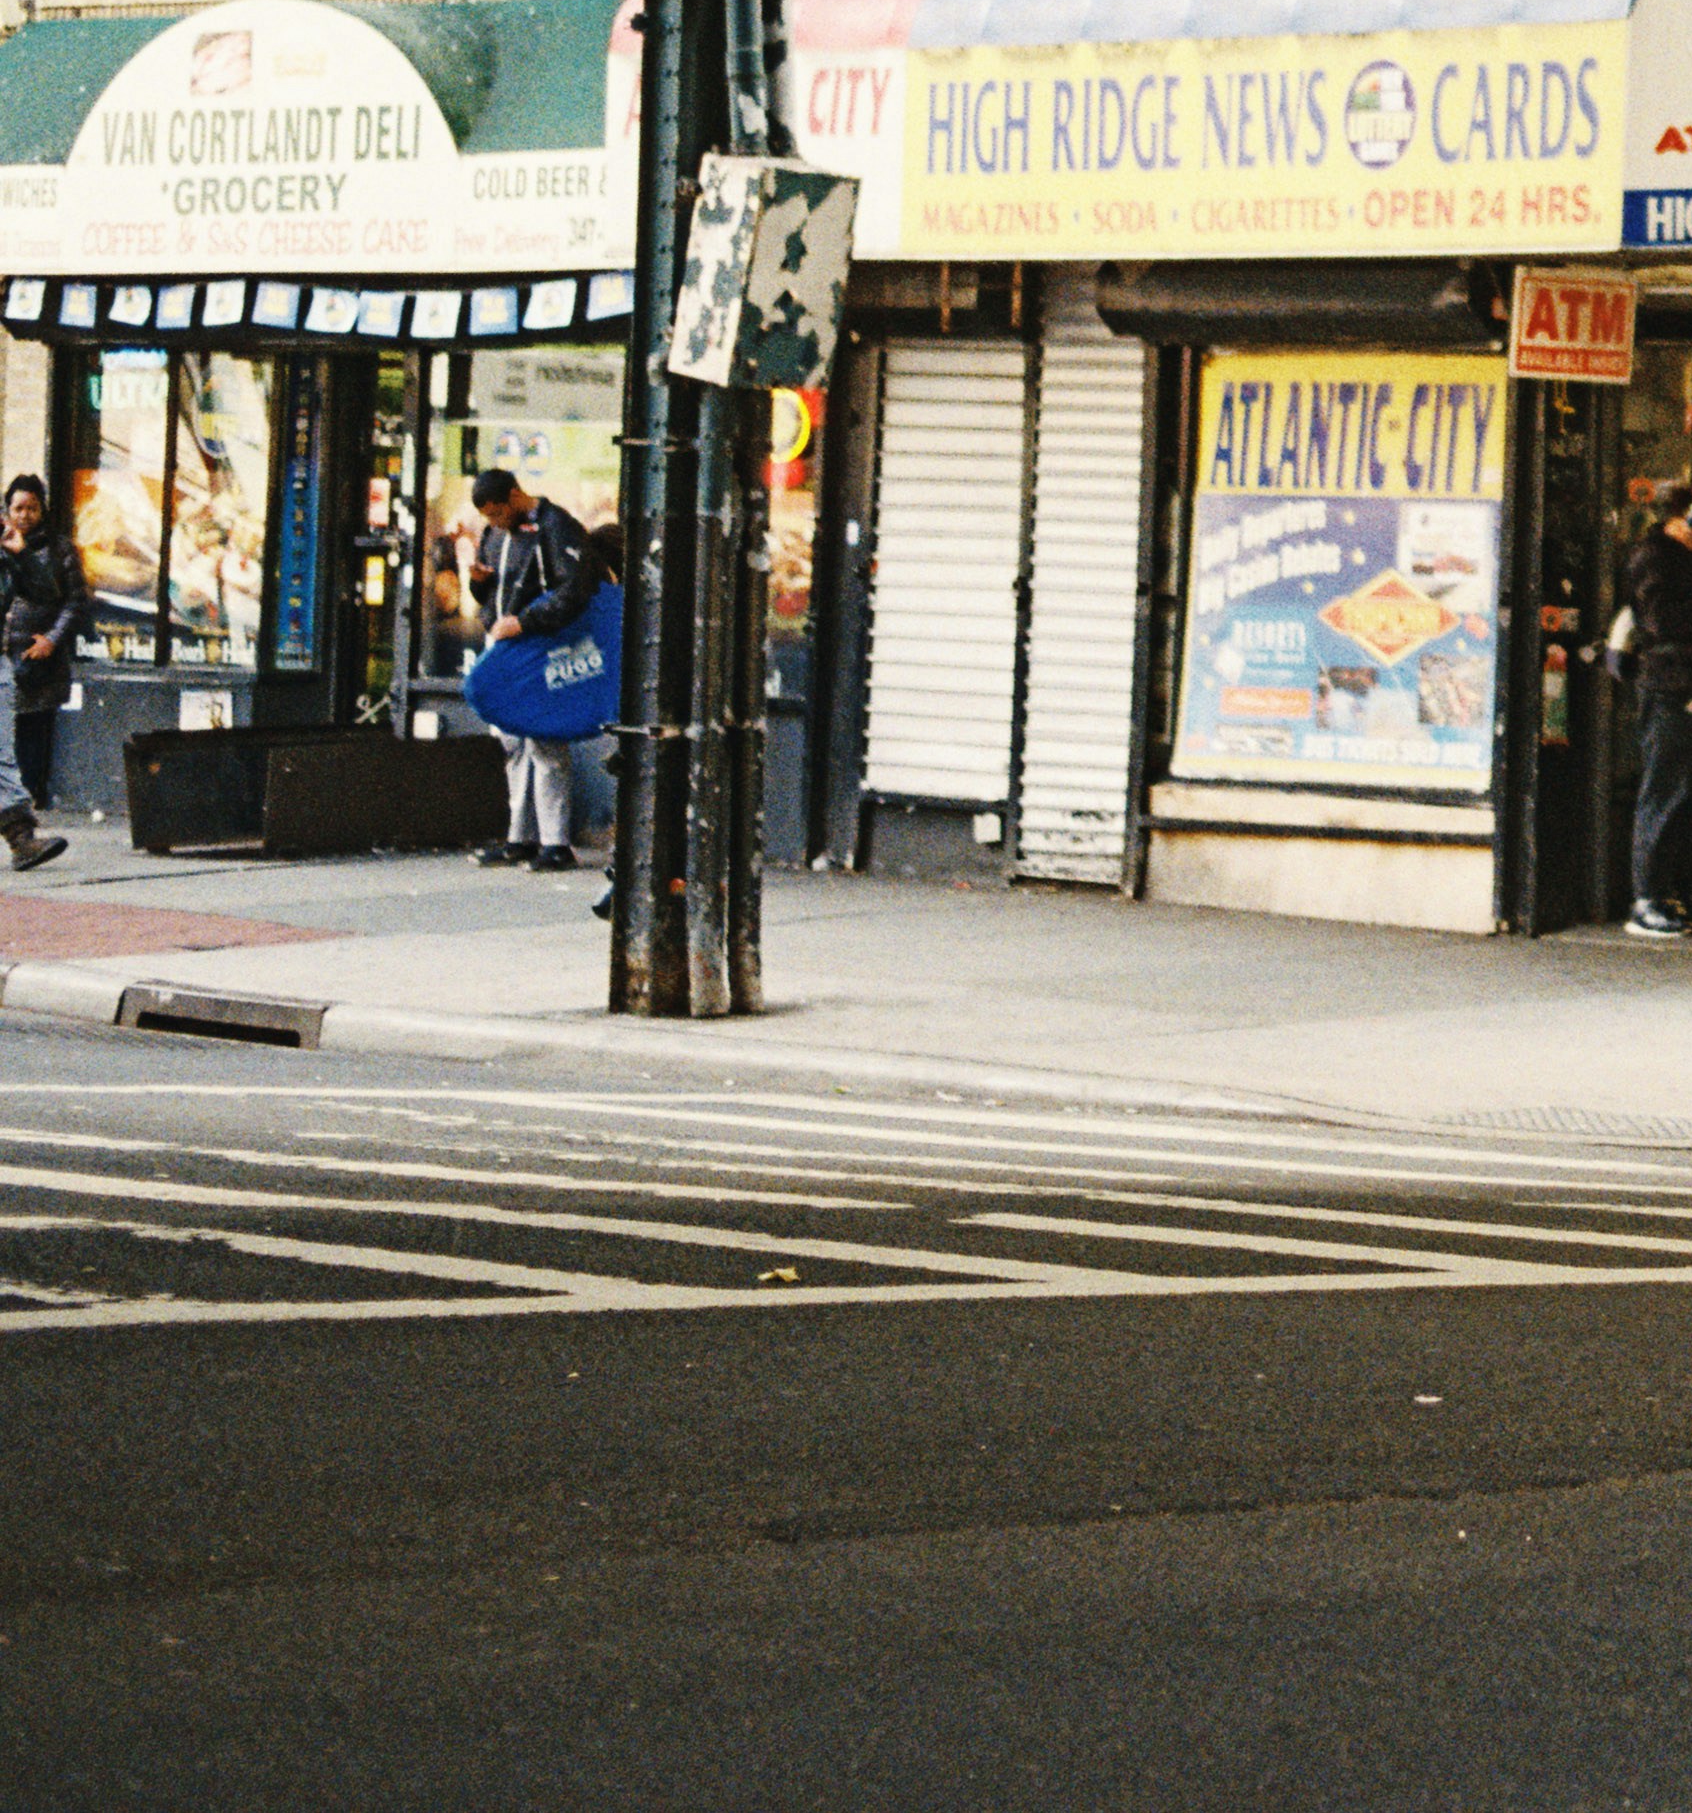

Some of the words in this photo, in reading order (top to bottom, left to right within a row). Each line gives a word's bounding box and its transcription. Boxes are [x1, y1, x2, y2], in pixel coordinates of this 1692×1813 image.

[807, 67, 892, 137] CITY
[928, 80, 1031, 176] HIGH
[1052, 74, 1181, 173] RIDGE
[1202, 69, 1329, 169] NEWS
[1432, 57, 1600, 165] CARDS
[103, 111, 157, 165] VAN
[168, 105, 342, 165] CORTLANDT
[354, 104, 421, 161] DELI
[473, 166, 530, 201] COLD
[536, 162, 593, 200] BEER
[922, 201, 1061, 237] MAGAZINES
[1091, 200, 1159, 235] SODA
[1190, 197, 1341, 235] CIGARETTES
[1363, 187, 1457, 229] OPEN
[1468, 188, 1507, 229] 24
[1519, 183, 1602, 228] HRS.
[363, 218, 430, 257] CAKE
[1526, 287, 1628, 344] ATM
[1210, 382, 1395, 490] ATLANTIC
[1402, 383, 1497, 493] CITY
